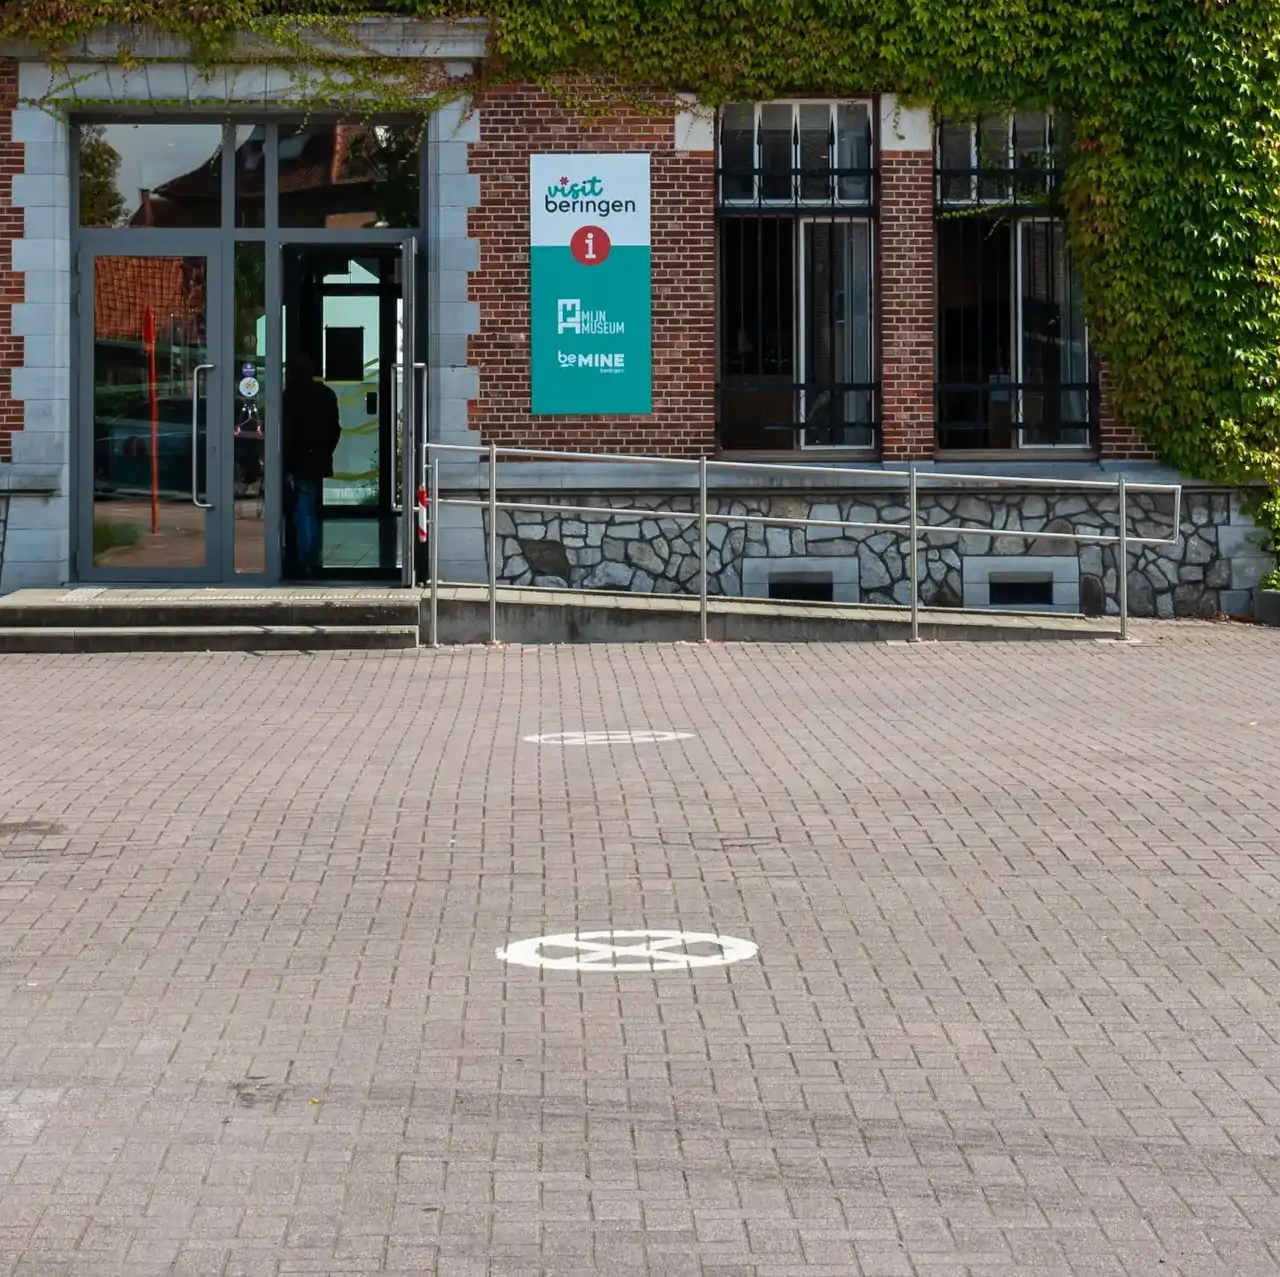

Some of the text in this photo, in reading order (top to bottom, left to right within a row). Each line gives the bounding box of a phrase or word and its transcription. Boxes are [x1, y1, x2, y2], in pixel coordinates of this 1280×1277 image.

[547, 176, 604, 200] visit
[544, 194, 636, 217] beringen
[581, 310, 606, 322] MIJN
[581, 322, 625, 334] MUSEUM
